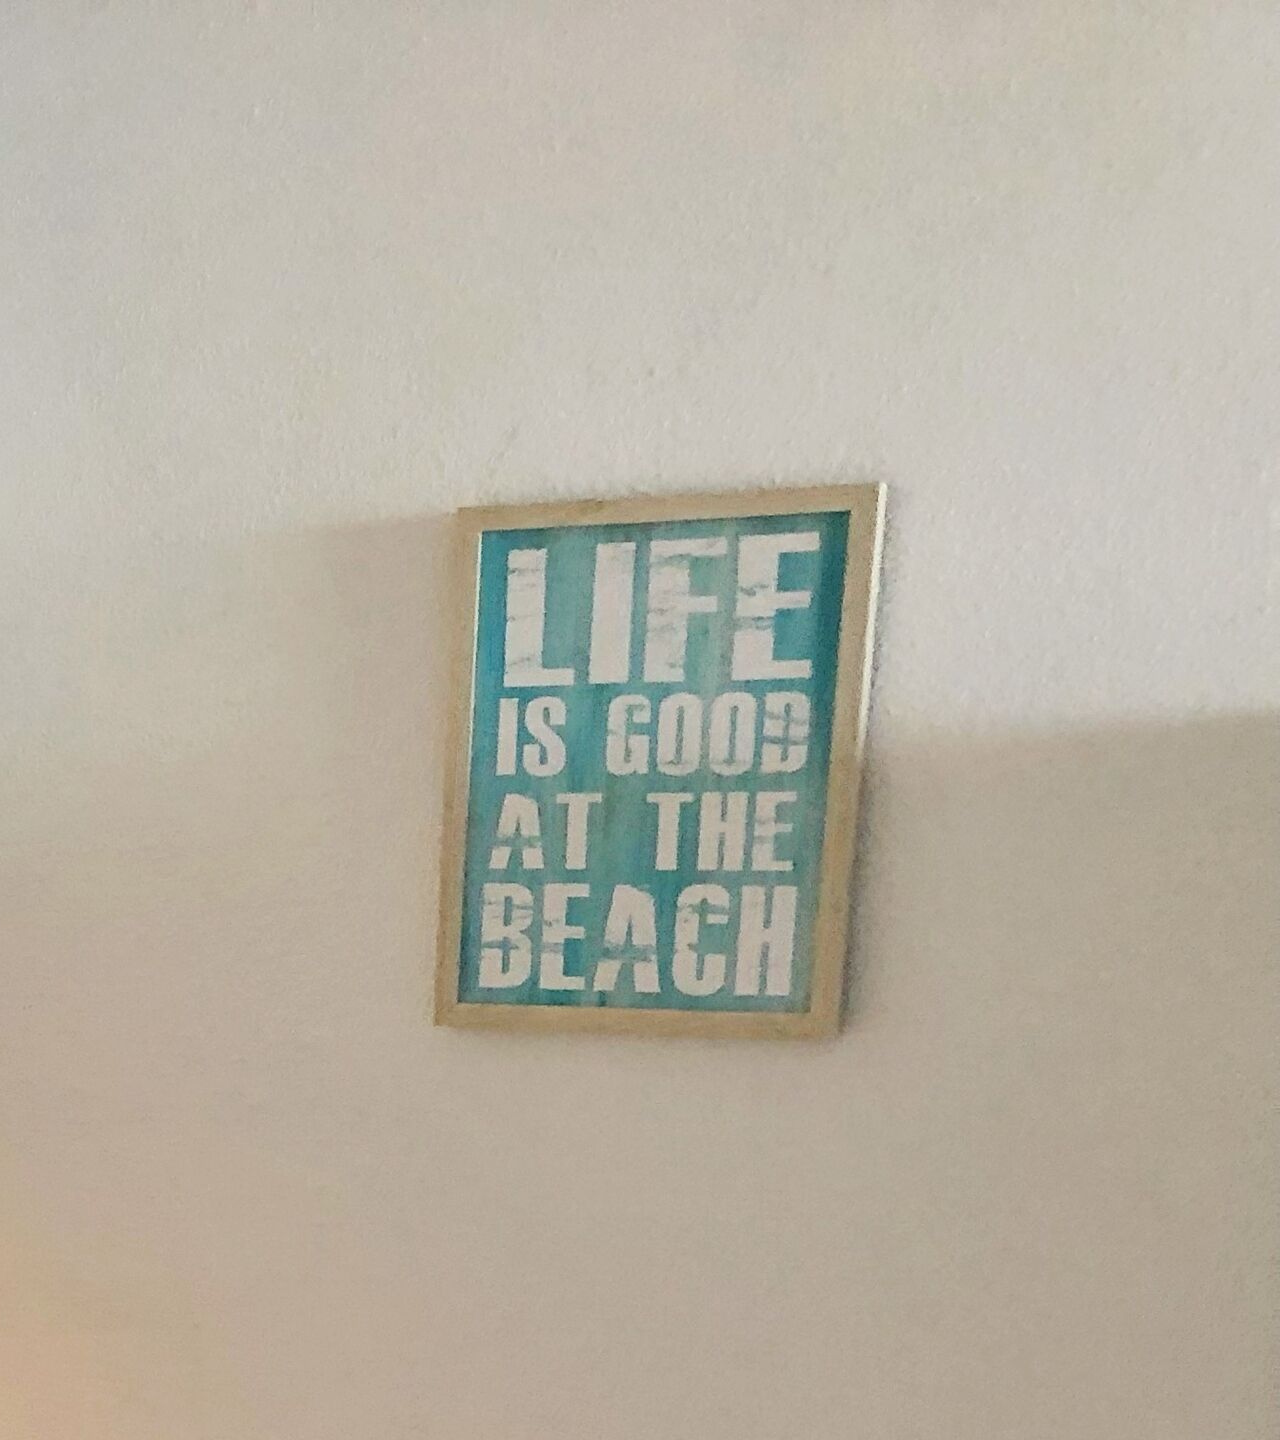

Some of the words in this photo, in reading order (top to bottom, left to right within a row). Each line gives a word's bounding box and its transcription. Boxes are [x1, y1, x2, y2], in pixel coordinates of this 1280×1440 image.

[503, 531, 821, 688] LIFE
[495, 695, 568, 778] IS
[605, 690, 811, 777] GOOD
[488, 792, 603, 871] AT
[646, 791, 798, 873] THE
[478, 881, 799, 998] BEACH
